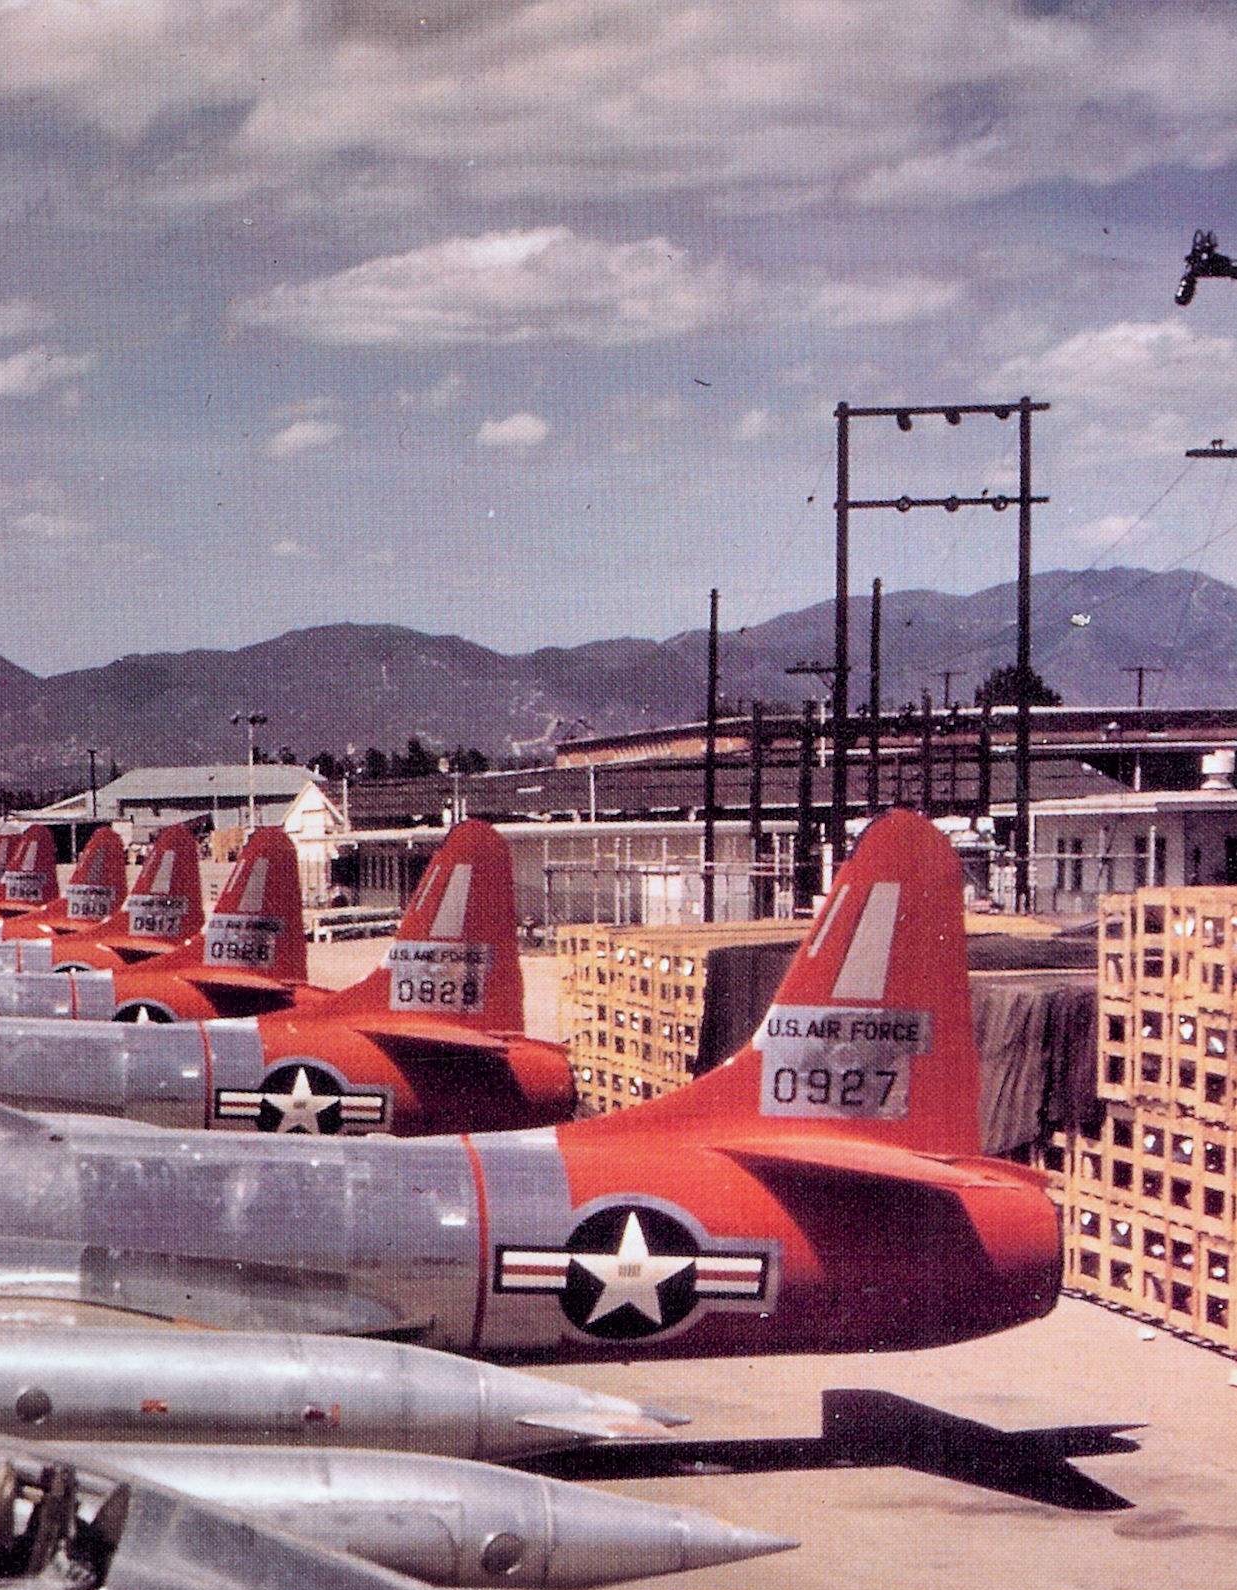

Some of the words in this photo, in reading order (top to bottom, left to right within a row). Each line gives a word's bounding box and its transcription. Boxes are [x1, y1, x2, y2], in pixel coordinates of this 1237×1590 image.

[806, 1020, 840, 1039] AIR
[851, 1021, 919, 1042] FORCE
[774, 1067, 897, 1106] 0927
